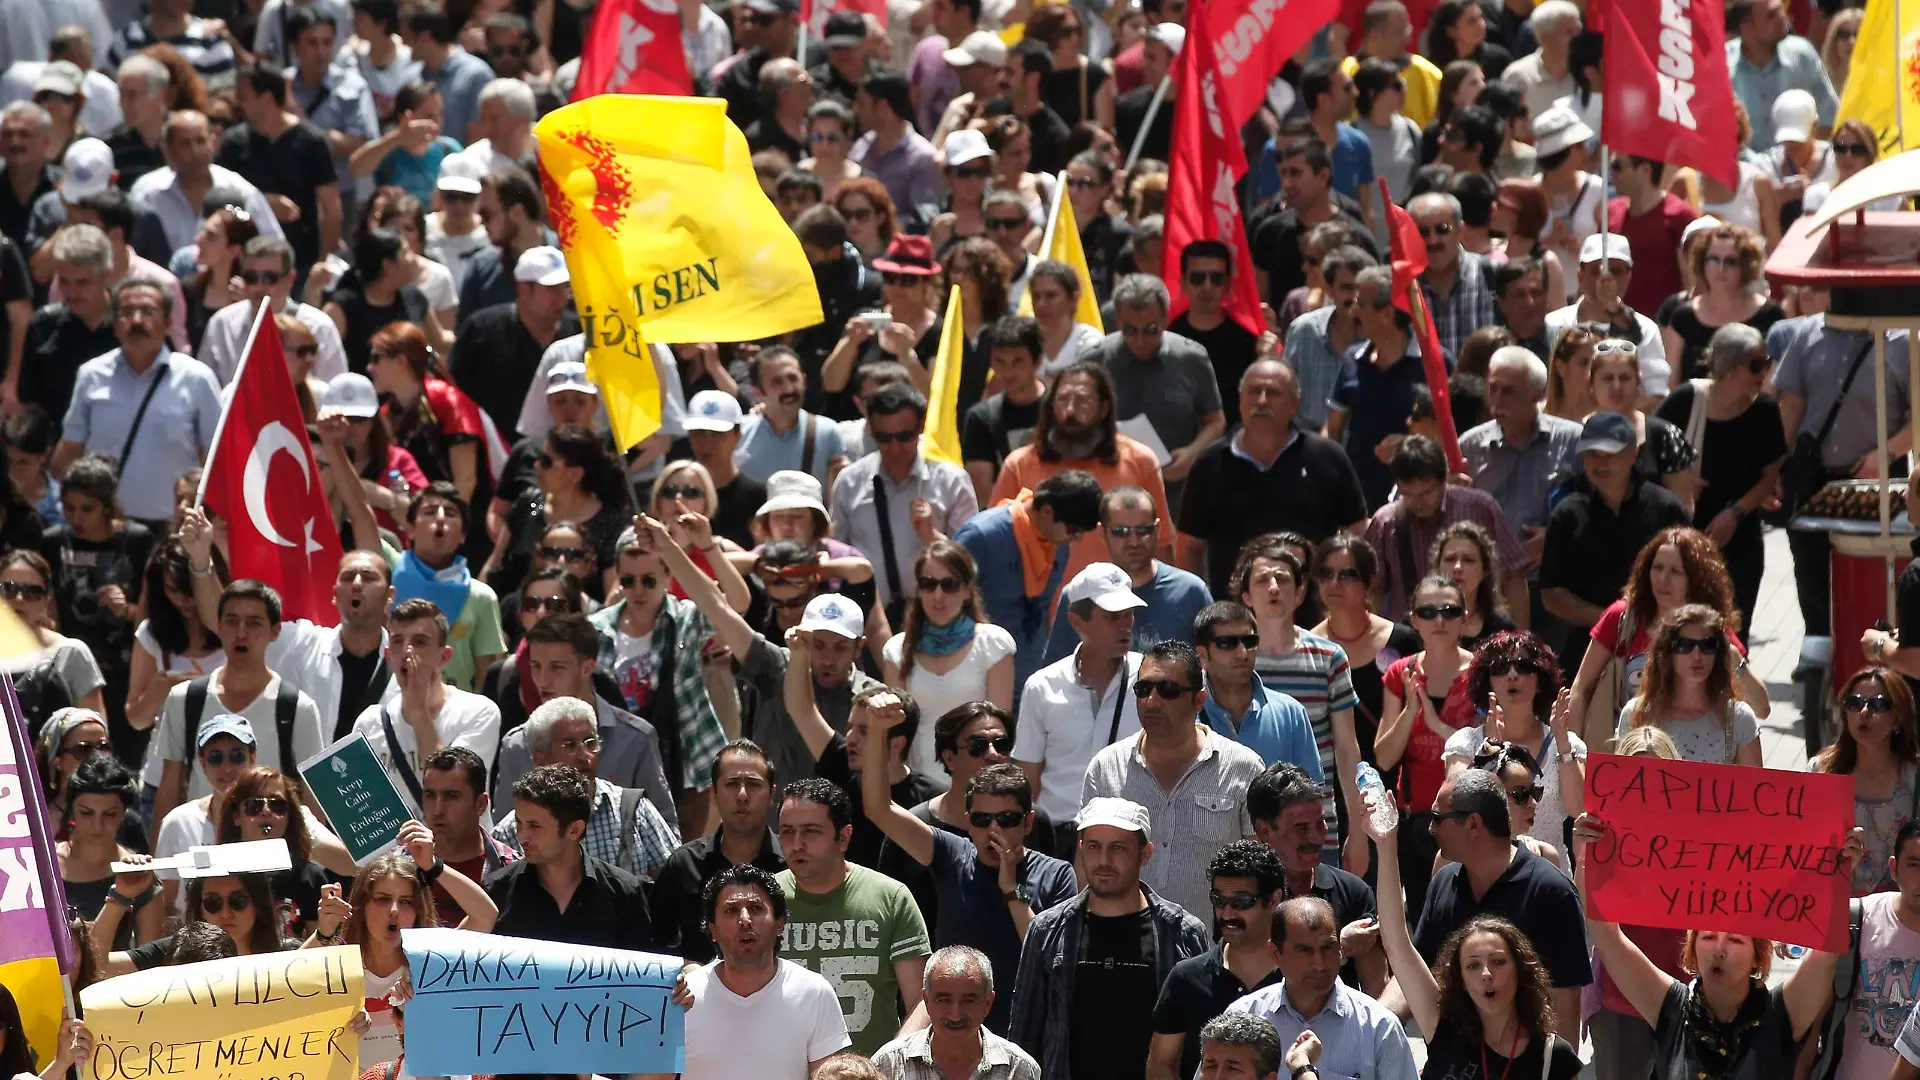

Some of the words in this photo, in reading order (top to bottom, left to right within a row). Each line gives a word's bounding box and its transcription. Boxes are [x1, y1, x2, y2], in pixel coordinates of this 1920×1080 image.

[653, 256, 720, 311] SEN
[336, 777, 363, 796] Keep
[345, 790, 372, 809] Calm
[358, 802, 370, 814] and
[1591, 761, 1806, 819] ÇAPULCU
[349, 805, 391, 833] Erdoğan
[354, 835, 367, 848] bi
[369, 827, 385, 840] sus
[384, 817, 401, 831] lan
[1591, 820, 1851, 881] ÖĞRETMENLER
[1659, 880, 1823, 936] YÜRÜYOR
[118, 954, 349, 1025] ÇAPULCU
[418, 948, 541, 989] DAKKA
[452, 992, 669, 1057] TAYYİP!
[93, 1026, 351, 1080] ÖĞRETMENLER
